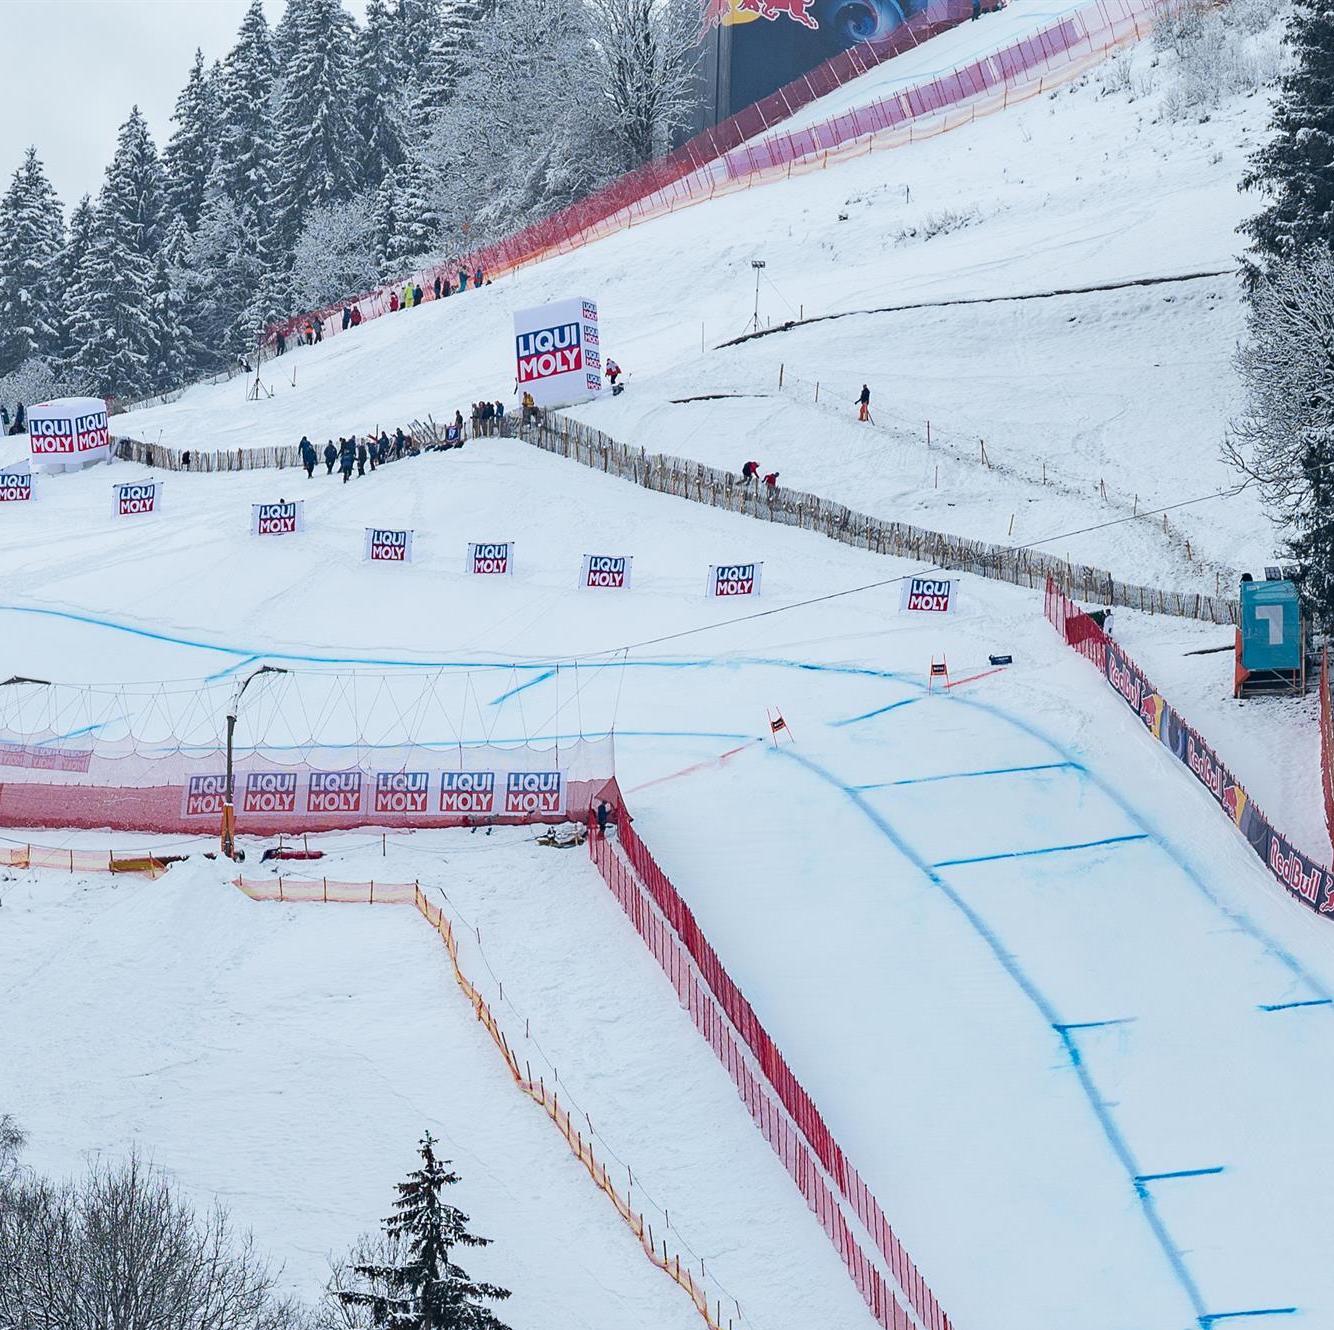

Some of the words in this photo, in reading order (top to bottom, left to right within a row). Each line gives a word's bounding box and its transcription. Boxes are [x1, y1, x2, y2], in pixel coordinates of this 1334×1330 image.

[518, 324, 578, 357] LIQUI
[519, 347, 580, 381] MOLY
[30, 420, 71, 436] LIQUI
[76, 413, 107, 433] LIQUI
[32, 436, 74, 453] MOLY
[78, 429, 109, 450] MOLY
[120, 485, 154, 500] LIQUI
[120, 499, 154, 514] MOLY
[261, 504, 295, 519] LIQUI
[260, 518, 295, 533] MOLY
[373, 530, 406, 545] LIQUI
[372, 546, 405, 560] MOLY
[475, 545, 507, 559] LIQUI
[474, 559, 506, 573] MOLY
[590, 558, 624, 573] LIQUI
[588, 572, 623, 586] MOLY
[717, 566, 753, 582] LIQUI
[717, 580, 753, 595] MOLY
[911, 581, 949, 596] LIQUI
[909, 596, 948, 611] MOLY
[248, 774, 296, 792] LIQUI
[311, 773, 359, 791] LIQUI
[378, 773, 427, 791] LIQUI
[443, 773, 493, 791] LIQUI
[509, 773, 558, 791] LIQUI
[246, 793, 295, 811] MOLY
[309, 792, 359, 811] MOLY
[377, 792, 427, 811] MOLY
[442, 792, 493, 811] MOLY
[508, 793, 558, 811] MOLY
